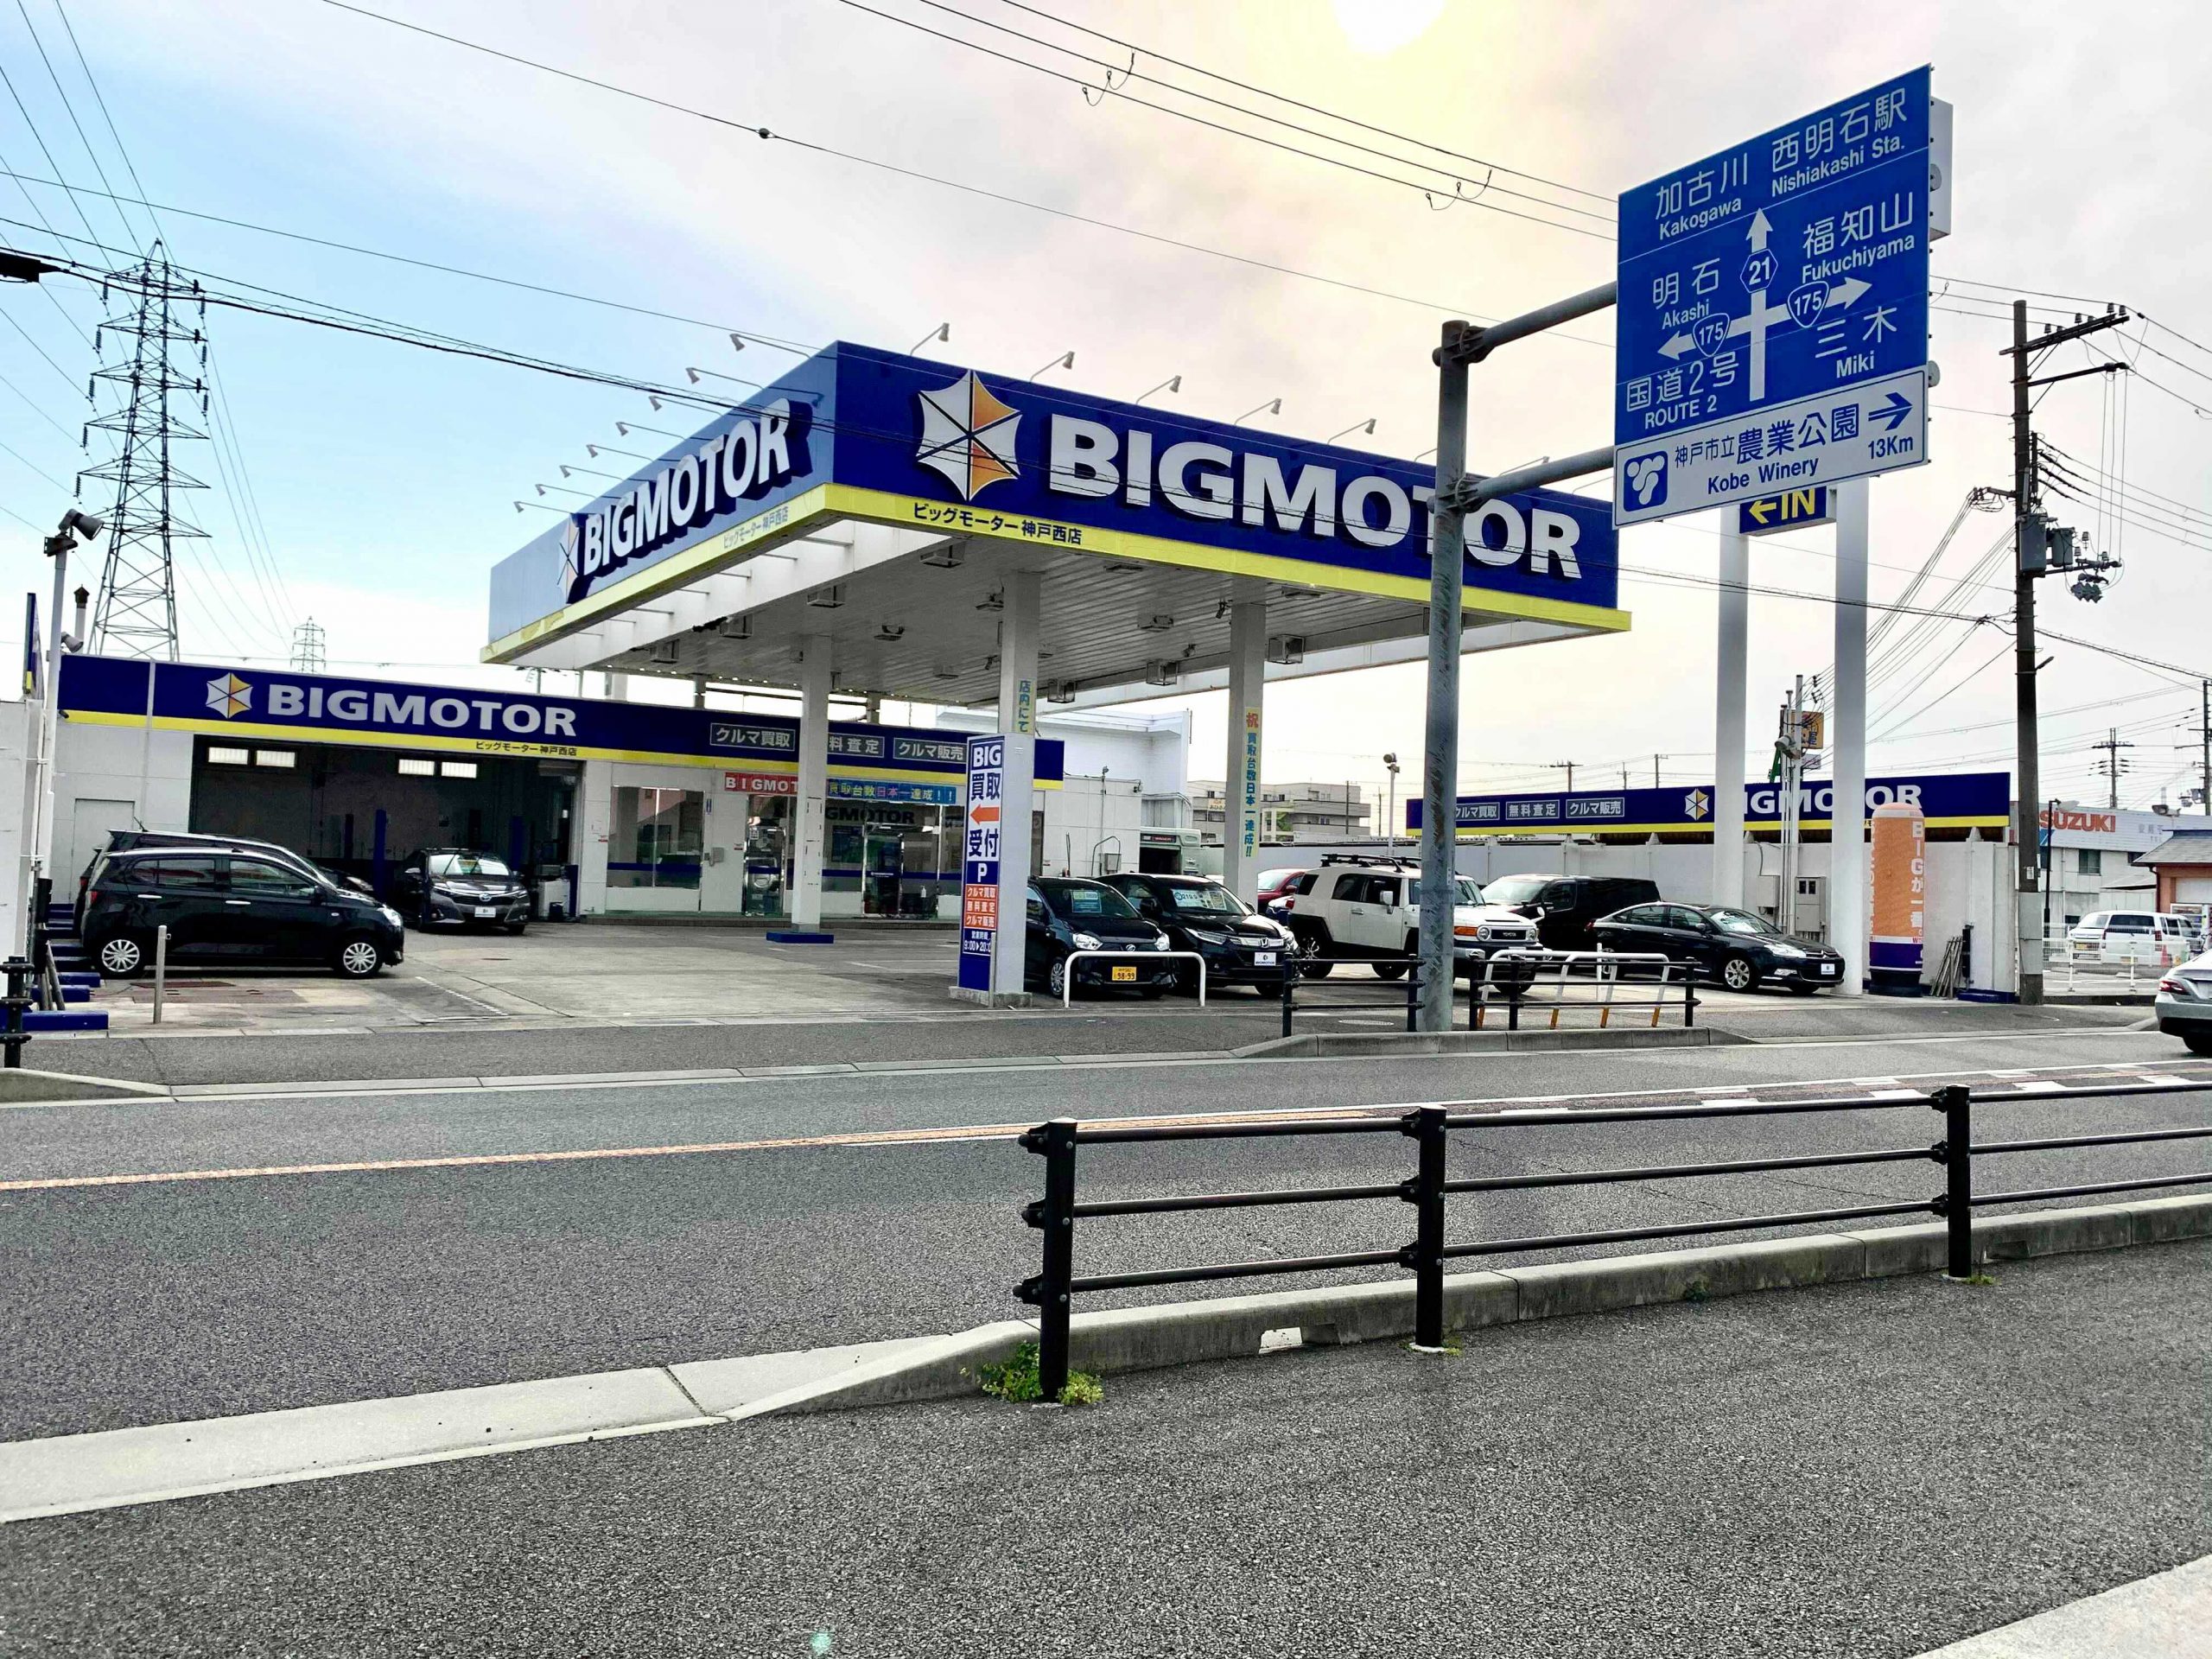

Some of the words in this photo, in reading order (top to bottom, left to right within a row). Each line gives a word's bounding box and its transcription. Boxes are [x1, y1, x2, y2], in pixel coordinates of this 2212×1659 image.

[1772, 87, 1907, 173] 西明石駅
[1772, 144, 1865, 198] Nishiakashi
[1872, 136, 1905, 159] Sta.
[1656, 152, 1747, 220] 加古川
[1660, 198, 1742, 240] Kakogawa
[1802, 192, 1914, 258] 福知山
[1749, 256, 1770, 286] 21
[1802, 234, 1915, 284] Fukuchiyama
[1652, 257, 1720, 309] 明石
[1662, 298, 1710, 330] Akashi
[1794, 289, 1823, 317] 175
[1699, 323, 1725, 346] 175
[1815, 305, 1897, 359] 三木
[1836, 350, 1875, 378] Miki
[1626, 351, 1739, 412] 国道2号
[1645, 401, 1700, 430] ROUTE
[1707, 394, 1718, 414] 2
[1675, 403, 1859, 469] 神戸市立農業公園
[1868, 435, 1914, 461] 13Km
[583, 397, 791, 576] BIGMOTOR
[1707, 471, 1751, 495] Kobe
[1758, 456, 1820, 483] Winery
[1781, 486, 1815, 520] IN
[913, 501, 1083, 545] ビッグモーター神戸西店
[268, 684, 577, 737] BIGMOTOR
[1246, 712, 1259, 728] 祝
[715, 728, 791, 747] クルマ買取
[829, 736, 880, 754] 料査定
[899, 743, 964, 761] クルマ販売
[973, 745, 1001, 767] BIG
[726, 777, 798, 792] BIGMOT
[971, 772, 1001, 801] 買取
[1509, 803, 1556, 817] 無料査定
[1569, 800, 1621, 816] クルマ販売
[2039, 810, 2116, 833] SUZUKI
[969, 828, 999, 857] 受付
[977, 862, 988, 882] P
